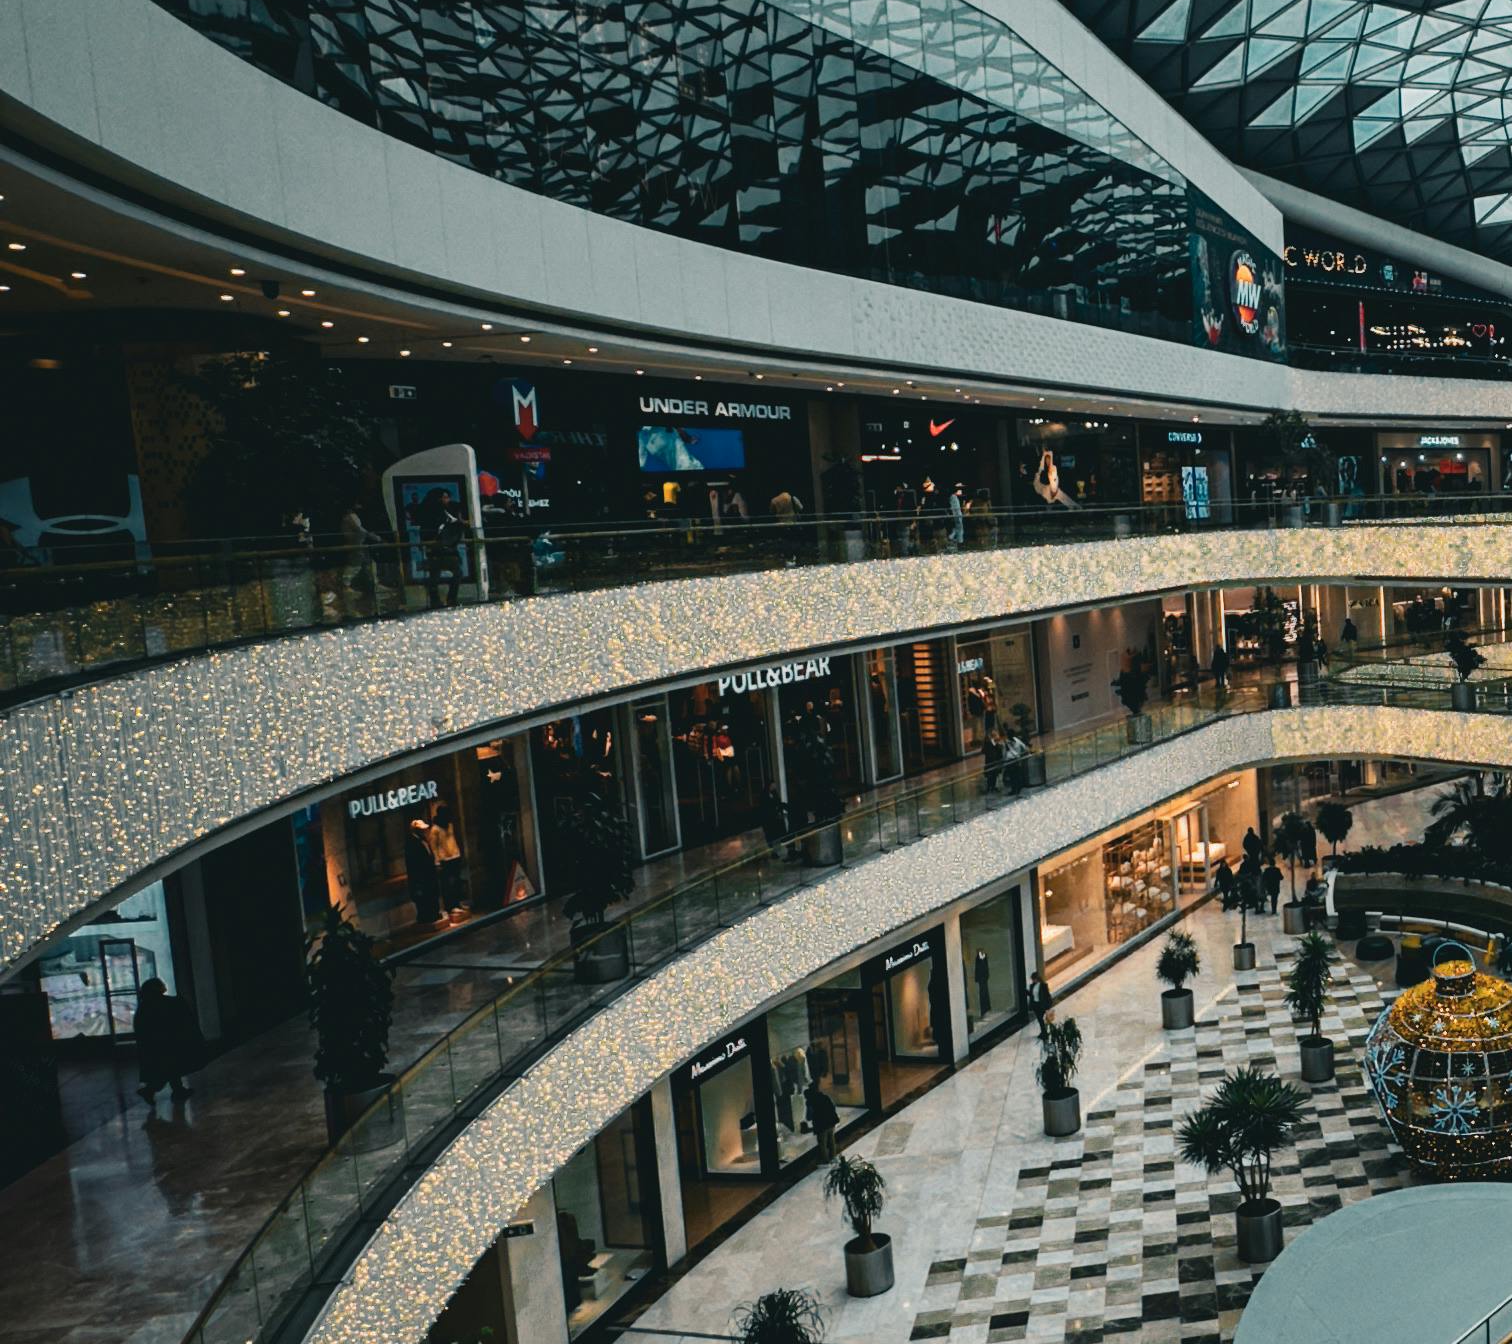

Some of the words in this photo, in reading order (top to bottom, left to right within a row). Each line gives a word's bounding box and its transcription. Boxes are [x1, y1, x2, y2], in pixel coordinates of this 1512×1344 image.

[1236, 279, 1262, 310] MW
[639, 396, 709, 416] UNDER
[714, 401, 792, 420] ARMOUR
[718, 656, 832, 697] PULL&BEAR
[348, 779, 439, 819] PULL&BEAR
